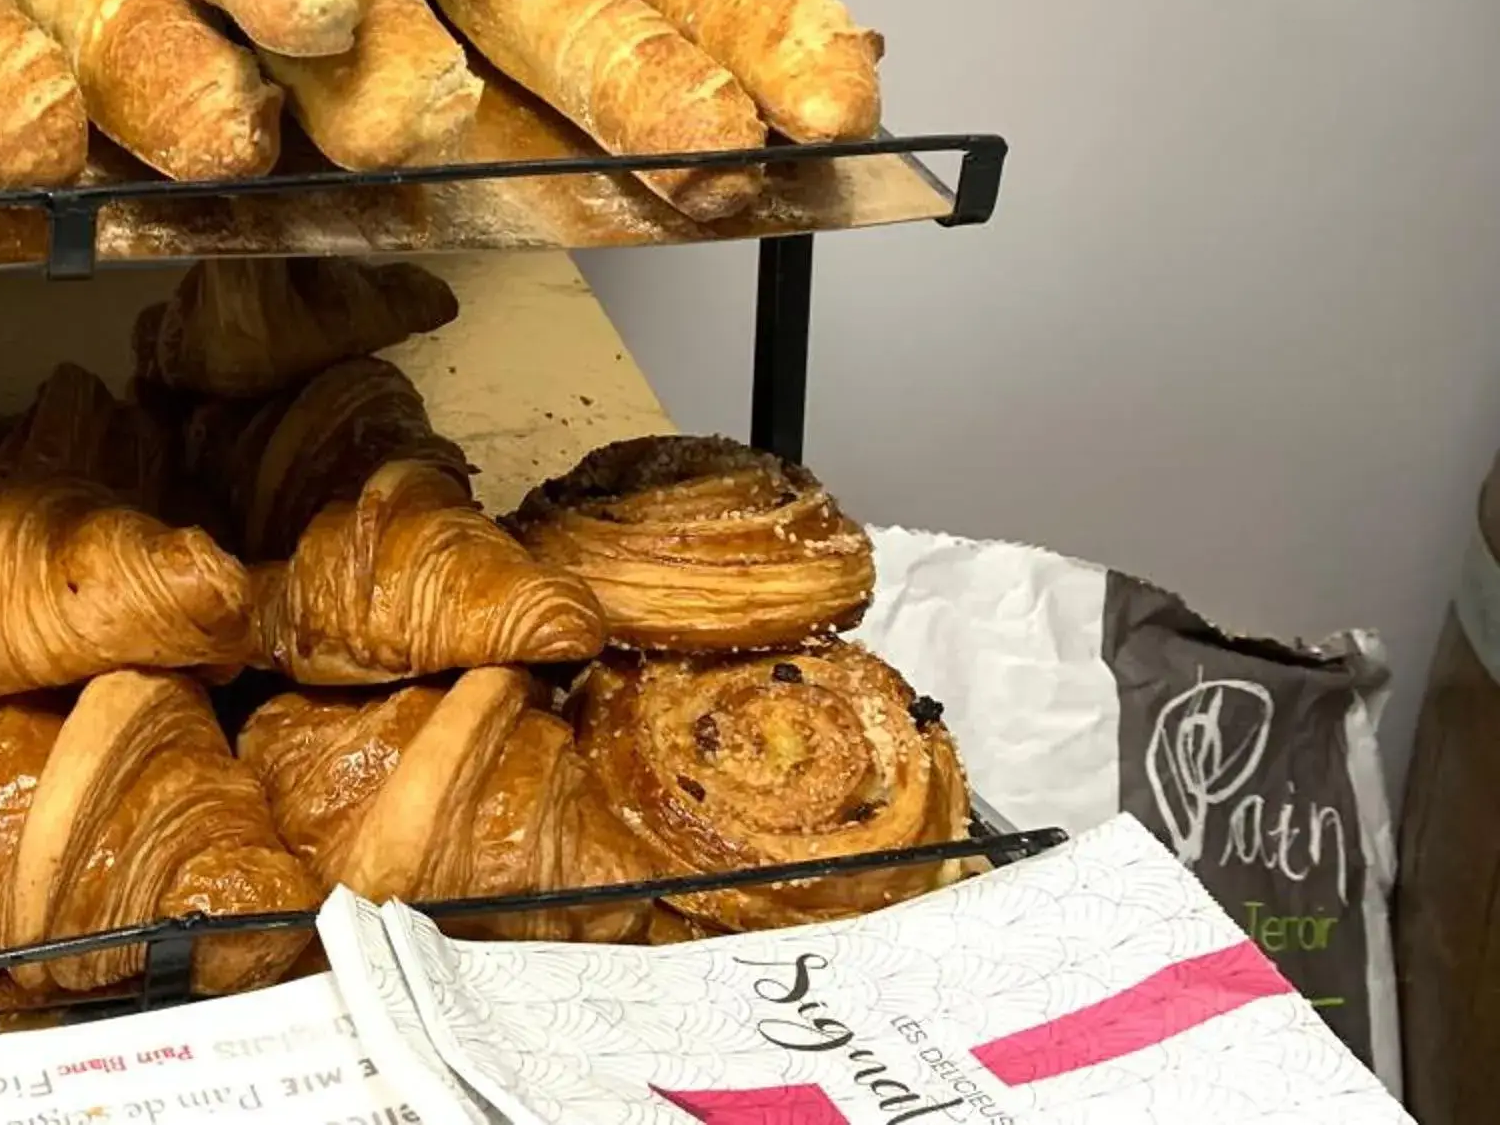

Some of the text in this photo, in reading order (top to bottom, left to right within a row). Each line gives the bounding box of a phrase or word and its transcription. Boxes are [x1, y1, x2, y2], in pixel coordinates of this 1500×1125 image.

[1146, 678, 1348, 905] Pain
[890, 1015, 928, 1044] LES
[57, 1055, 127, 1076] Blanc
[136, 1044, 194, 1065] Pain
[281, 1067, 343, 1097] MIE
[123, 1097, 166, 1125] de
[176, 1083, 264, 1114] Pain
